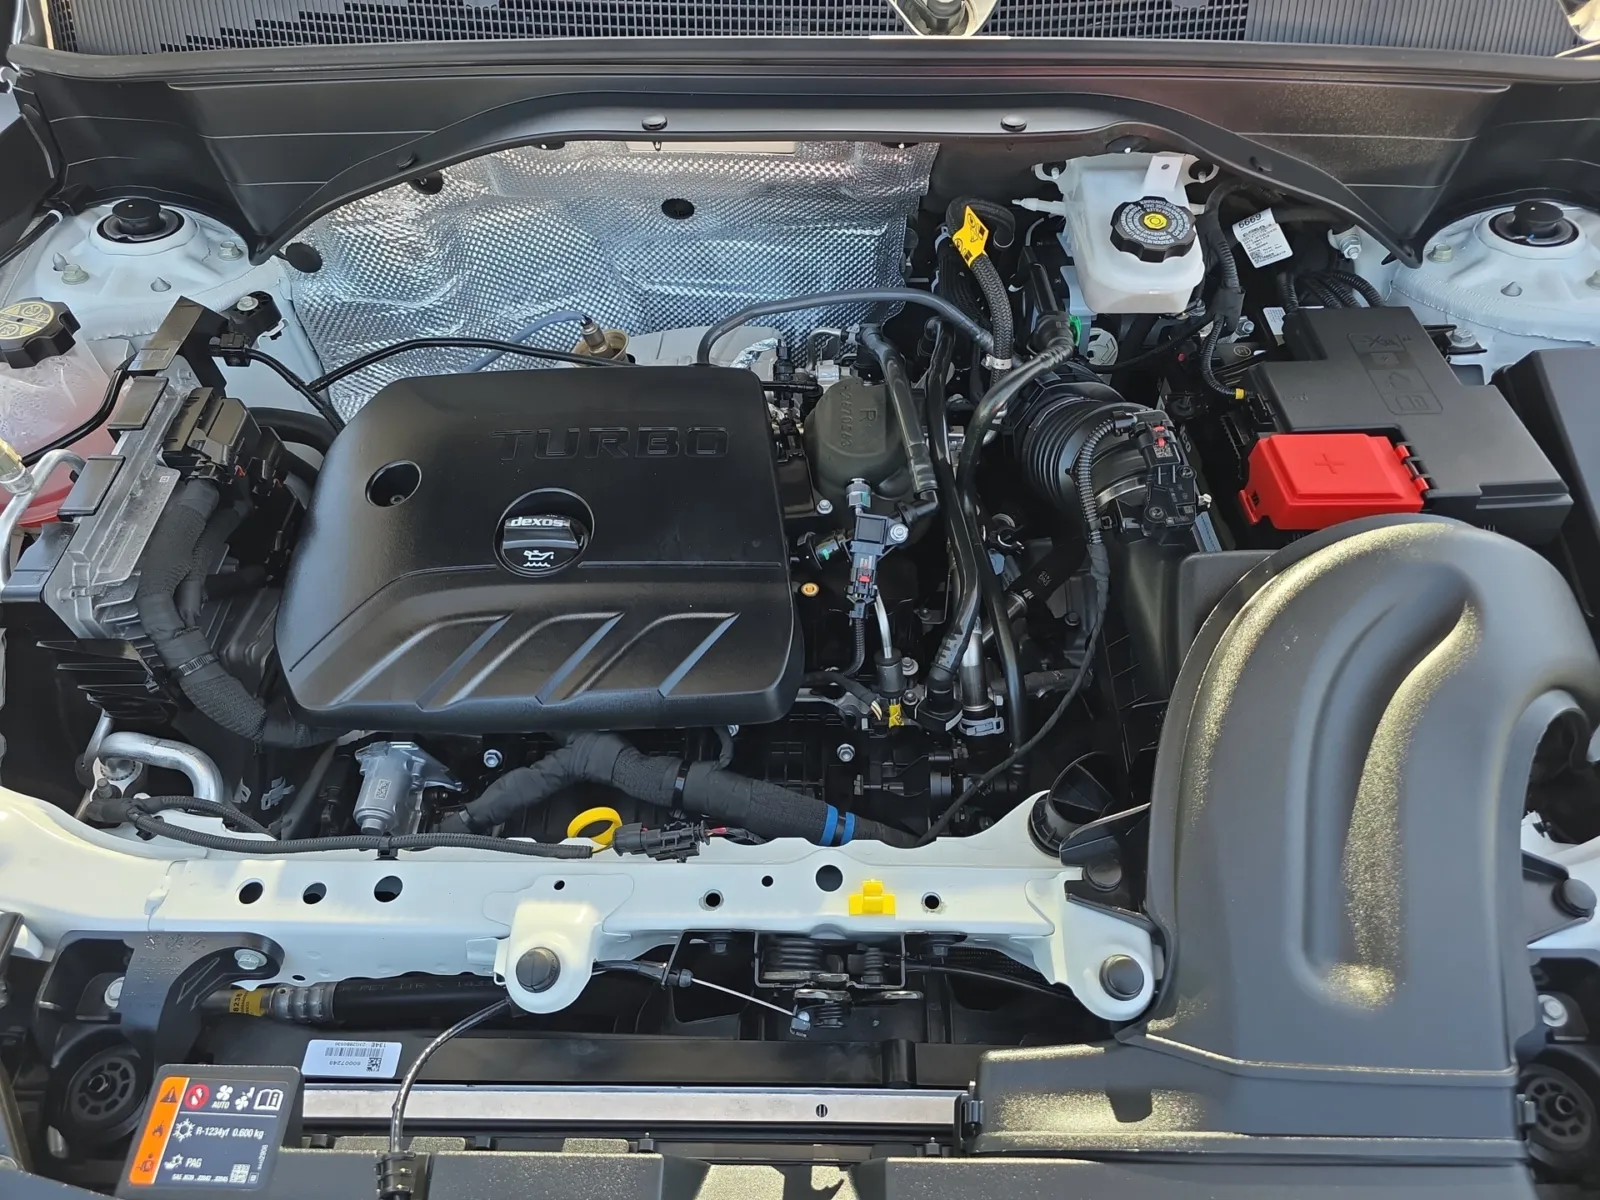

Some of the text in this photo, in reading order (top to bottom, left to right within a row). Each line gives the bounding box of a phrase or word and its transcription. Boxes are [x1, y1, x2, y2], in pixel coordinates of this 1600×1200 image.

[1238, 213, 1262, 229] 6669
[859, 408, 877, 422] R
[491, 426, 729, 461] TURBO
[510, 515, 565, 528] dexos
[211, 1101, 230, 1109] AUTO
[231, 1128, 254, 1138] 0.600
[253, 1129, 265, 1140] kg
[185, 1157, 203, 1169] PAG
